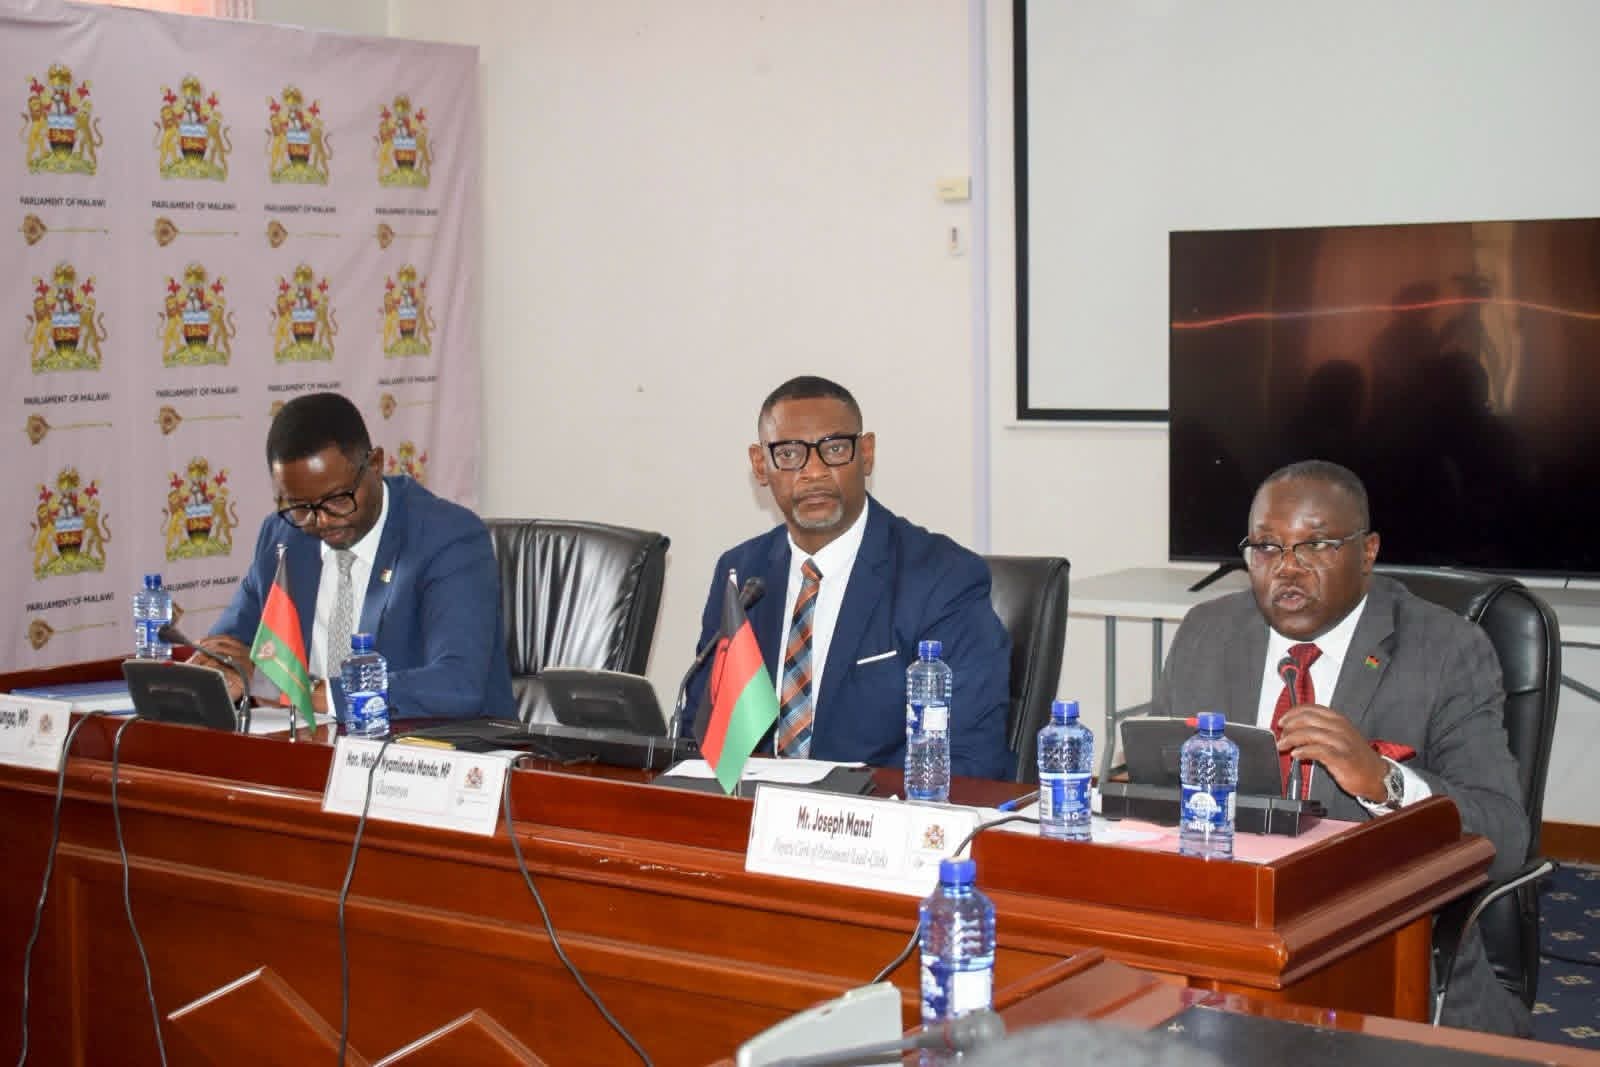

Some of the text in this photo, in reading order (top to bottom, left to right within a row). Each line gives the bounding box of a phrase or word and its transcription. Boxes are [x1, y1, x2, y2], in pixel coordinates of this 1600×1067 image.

[19, 196, 106, 209] PARLIAMENT OF MALAWI
[152, 200, 194, 210] PARLIAMENT
[207, 202, 237, 212] MALAWI
[24, 394, 68, 406] PARLIAMENT
[80, 392, 111, 402] MALAWI
[156, 388, 199, 399] PARLIAMENT
[210, 385, 239, 395] MALAWI
[200, 578, 211, 588] OF
[212, 574, 239, 585] MALAWI
[26, 591, 115, 612] PARLIAMENT OF MALAWI
[796, 805, 874, 839] Mr. Joseph Manzi
